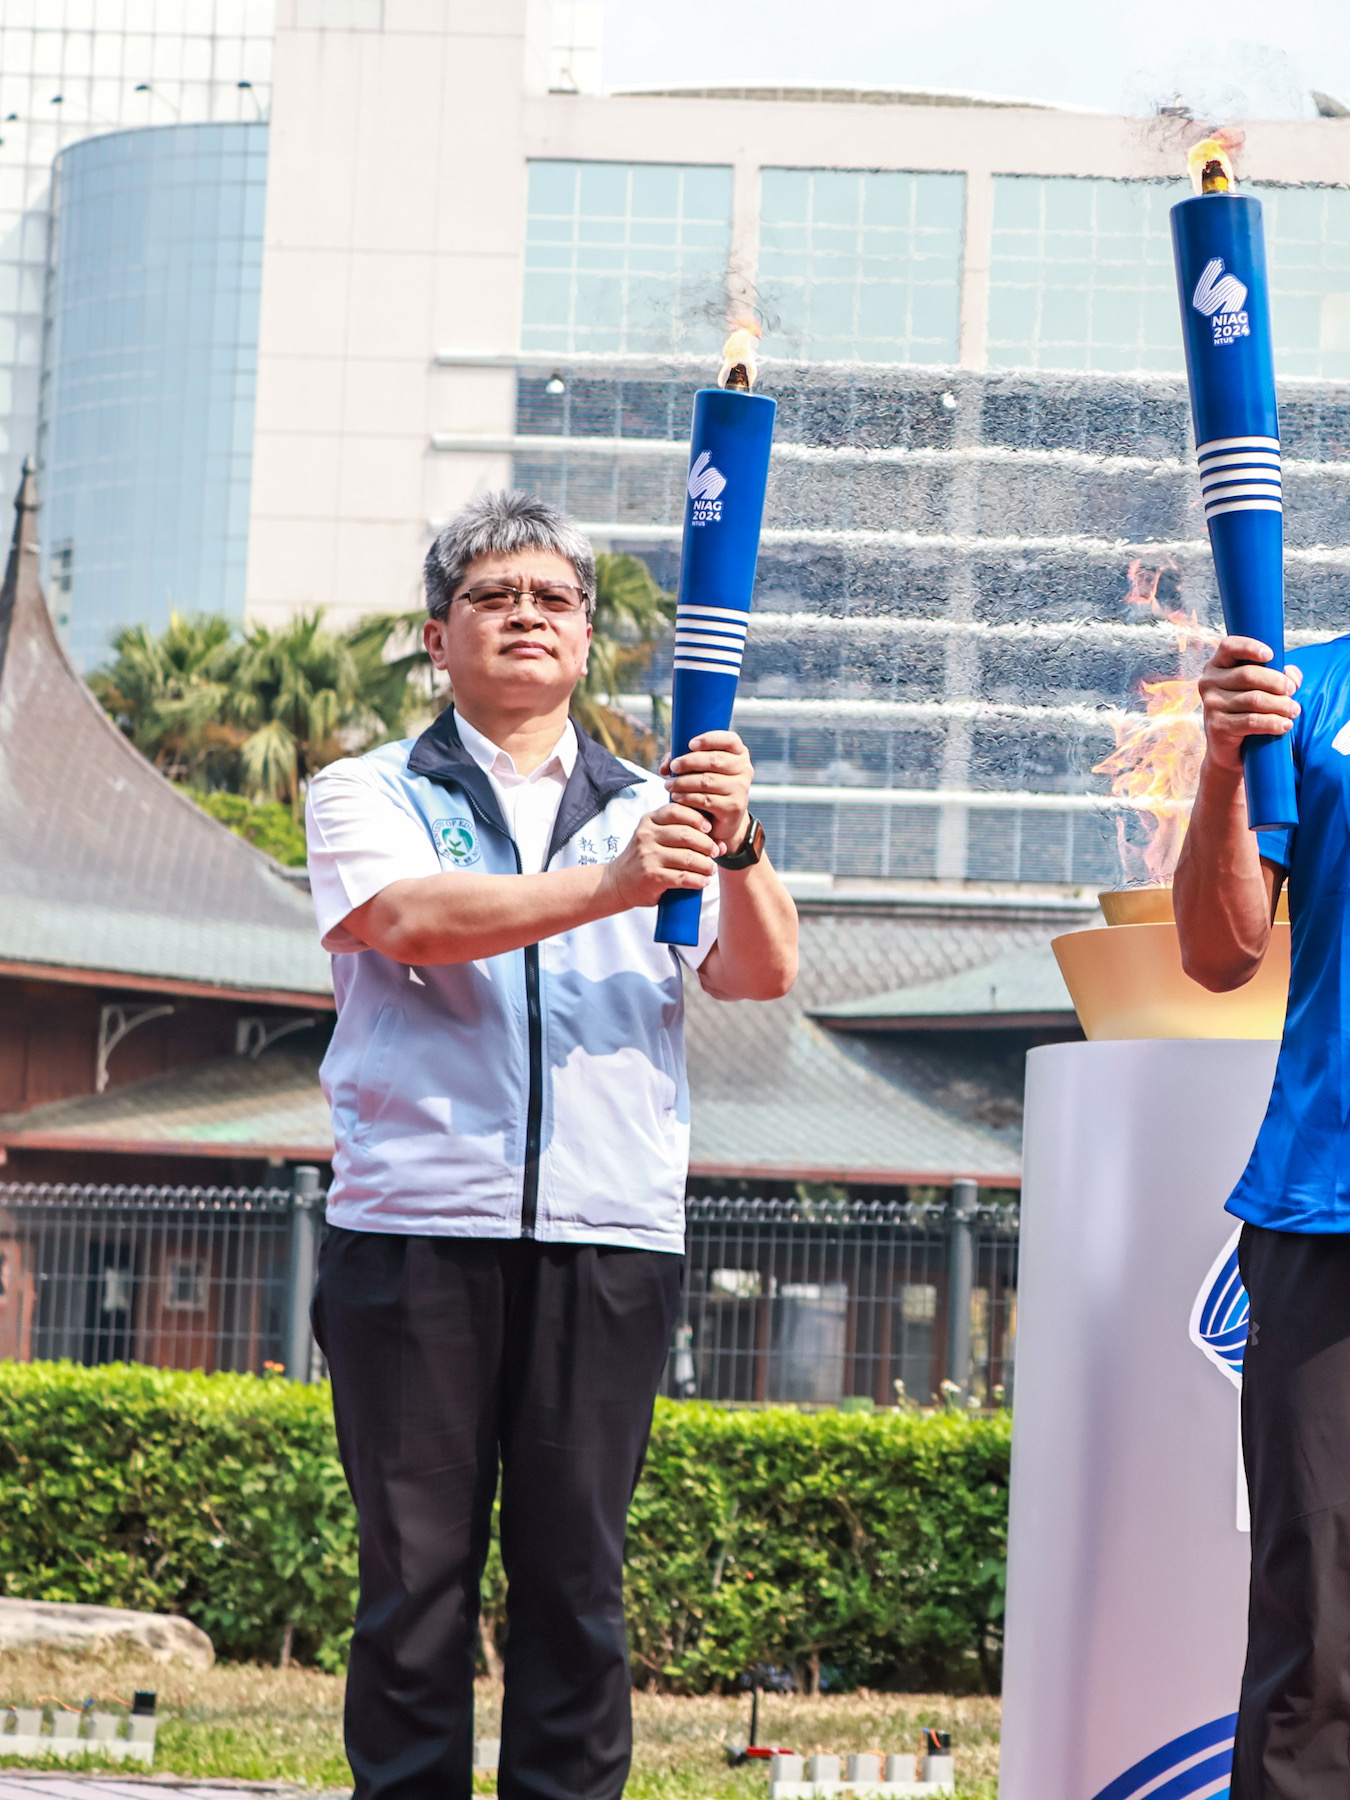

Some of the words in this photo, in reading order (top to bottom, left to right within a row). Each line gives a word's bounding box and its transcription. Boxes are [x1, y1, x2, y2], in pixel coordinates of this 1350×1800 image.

[1212, 313, 1248, 327] NIAG
[1213, 325, 1250, 338] 2024
[1213, 337, 1233, 345] NTUS
[693, 501, 722, 511] NIAG
[692, 511, 721, 521] 2024
